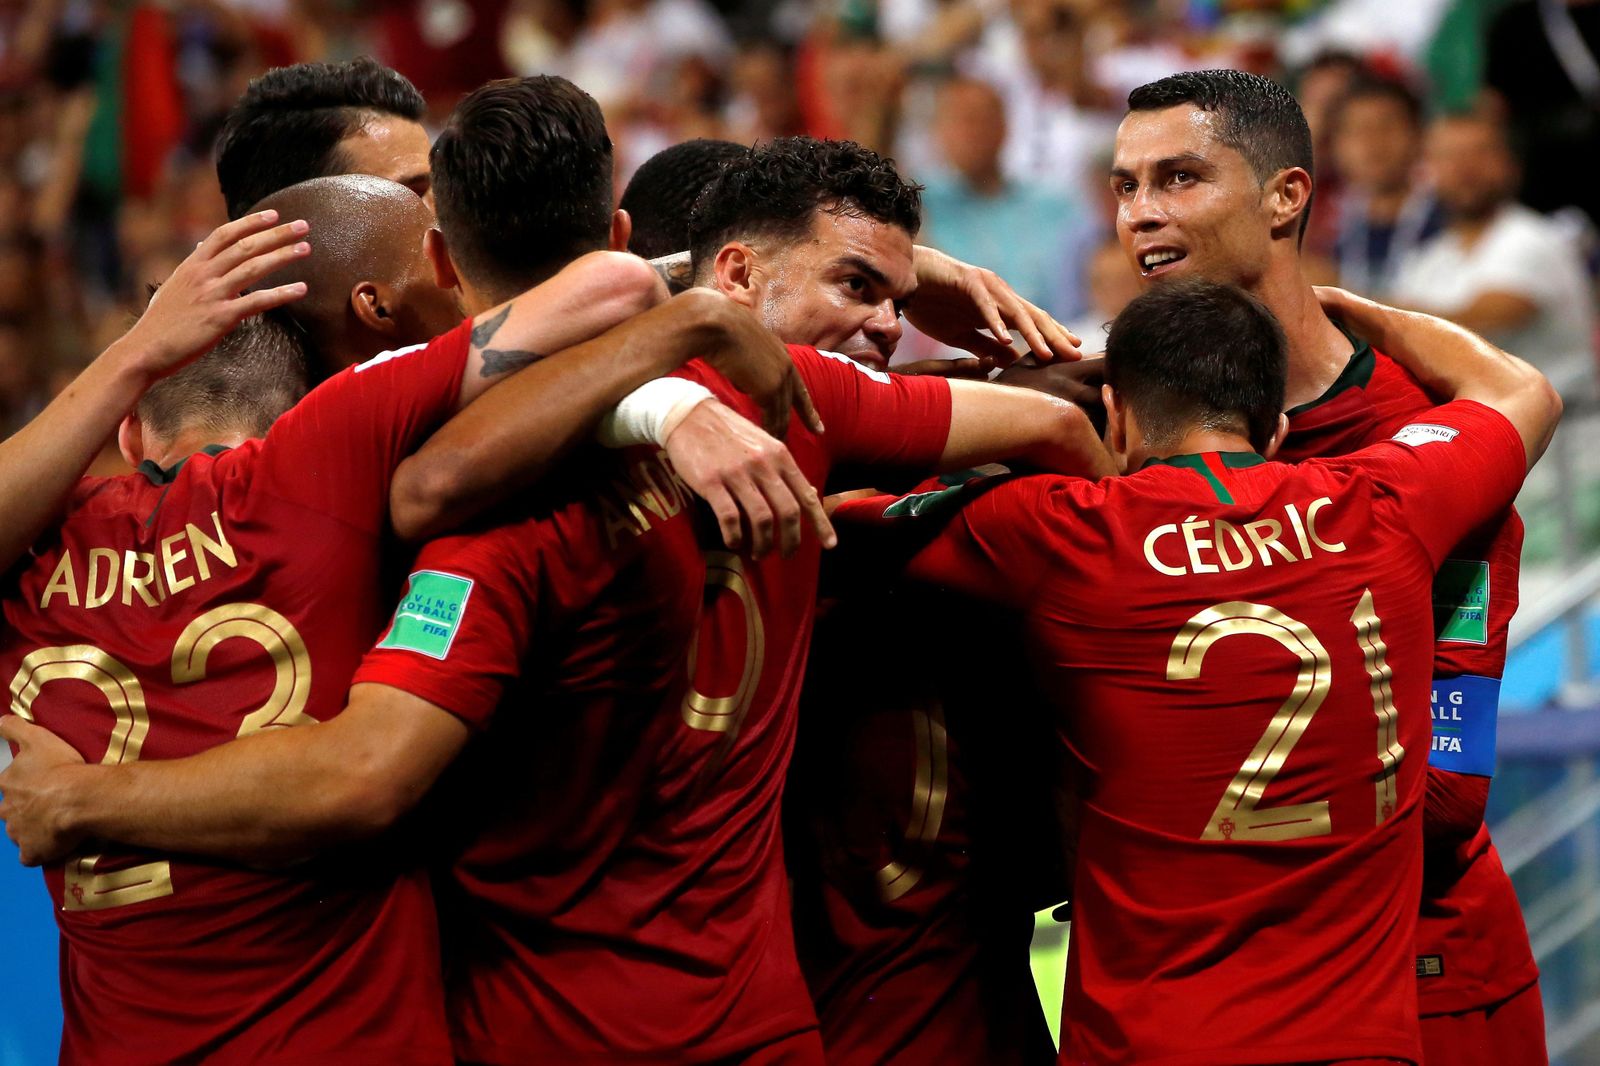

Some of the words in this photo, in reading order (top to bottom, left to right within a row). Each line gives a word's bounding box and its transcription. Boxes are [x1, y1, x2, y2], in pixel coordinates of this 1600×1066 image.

[40, 511, 238, 609] ADRIEN
[1143, 496, 1346, 577] CÉDRIC
[423, 624, 448, 638] FIFA
[1459, 611, 1482, 622] FIFA
[1166, 587, 1406, 841] 21
